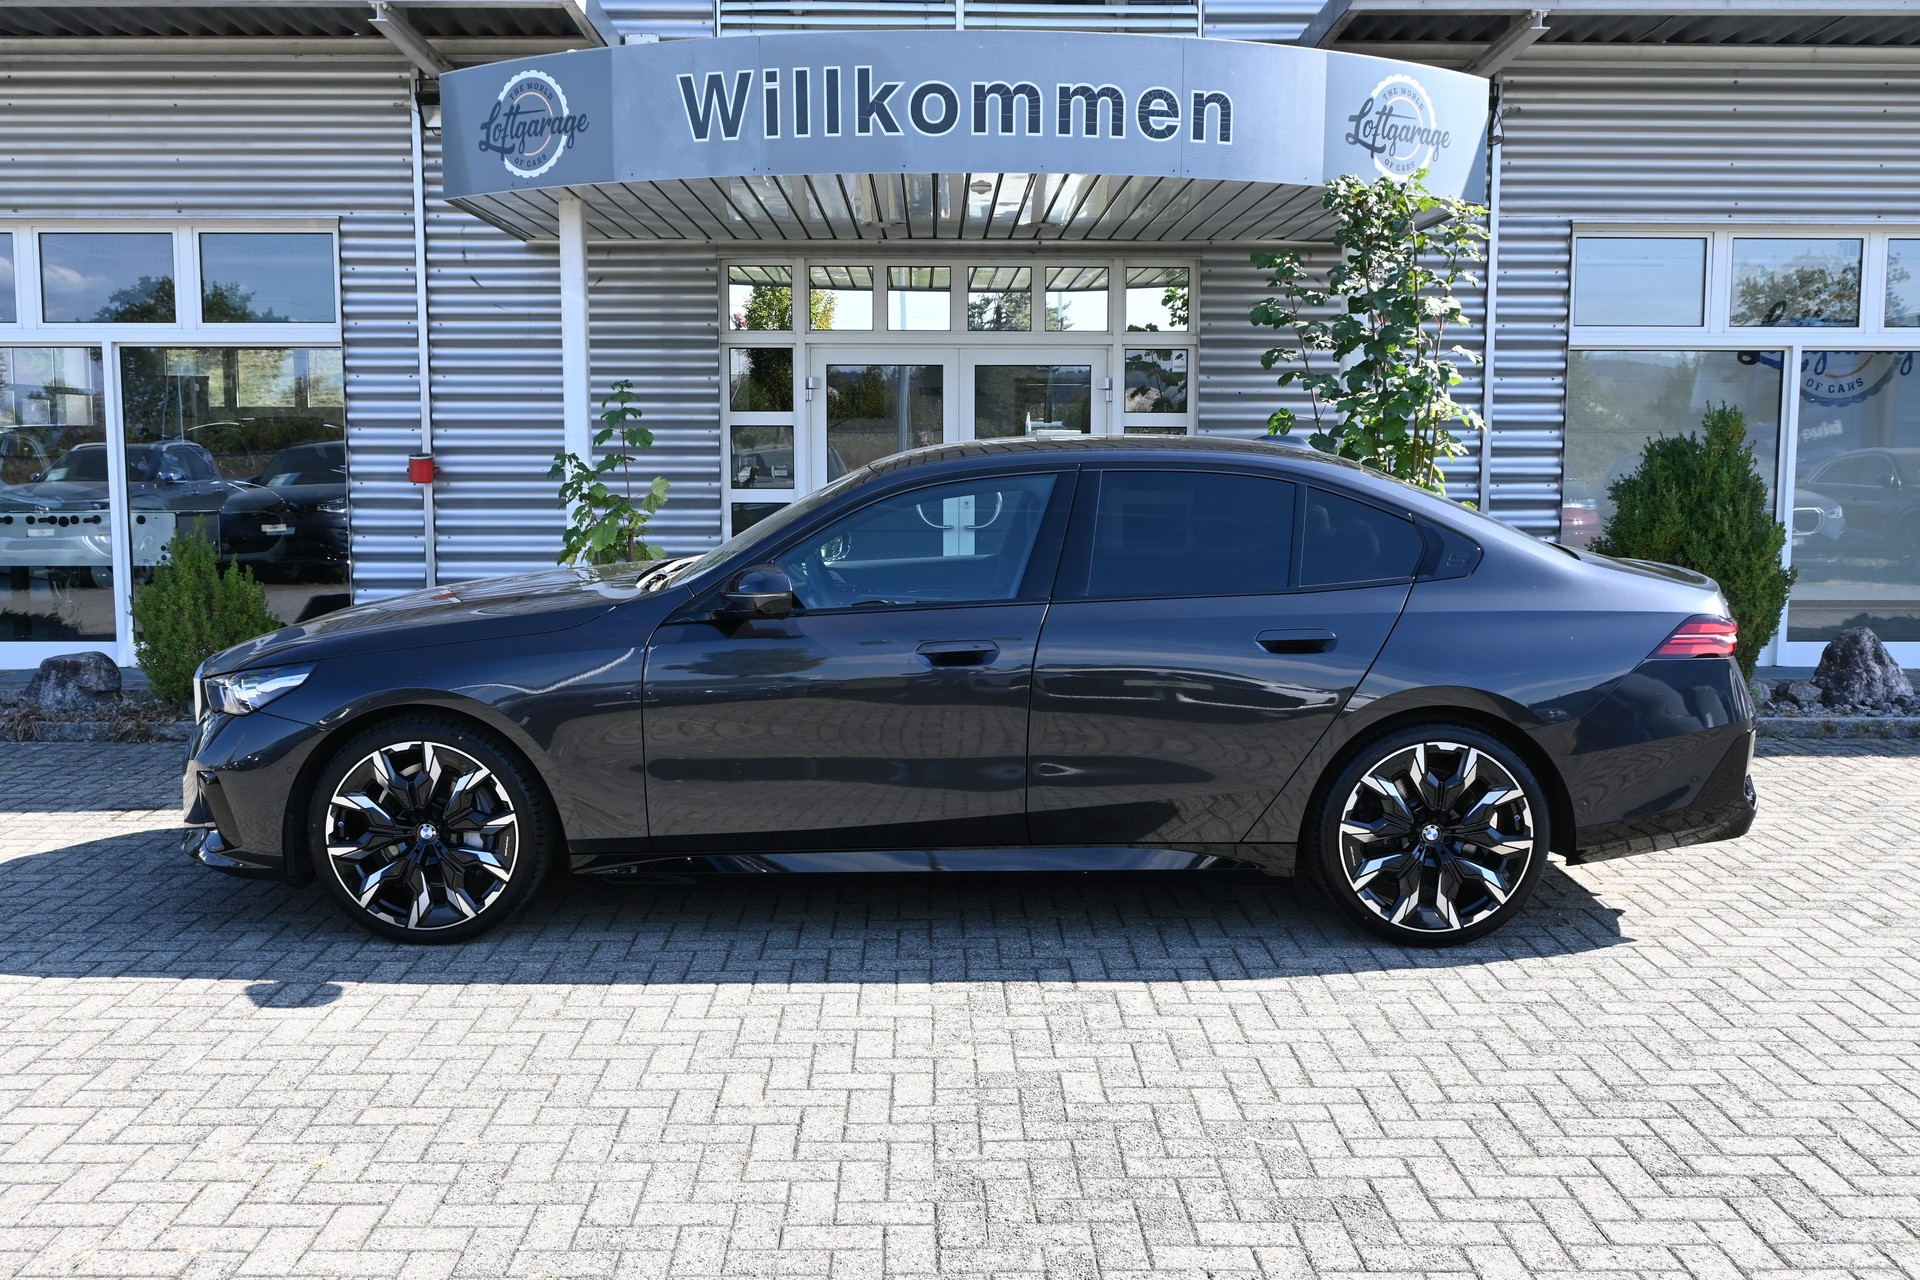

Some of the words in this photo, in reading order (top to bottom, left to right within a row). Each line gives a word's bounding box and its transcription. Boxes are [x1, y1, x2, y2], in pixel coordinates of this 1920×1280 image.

[509, 84, 524, 100] THE
[527, 82, 554, 100] WORLD
[1382, 87, 1398, 100] THE
[1400, 87, 1424, 110] WORLD
[676, 65, 1234, 145] Willkommen
[478, 100, 590, 161] Loftgarage
[1345, 97, 1452, 162] Loftgarage
[514, 157, 524, 166] OF
[527, 154, 547, 167] CARS
[1384, 158, 1395, 168] OF
[1396, 161, 1416, 172] CARS
[1806, 378, 1823, 391] OF
[1828, 377, 1864, 393] CARS
